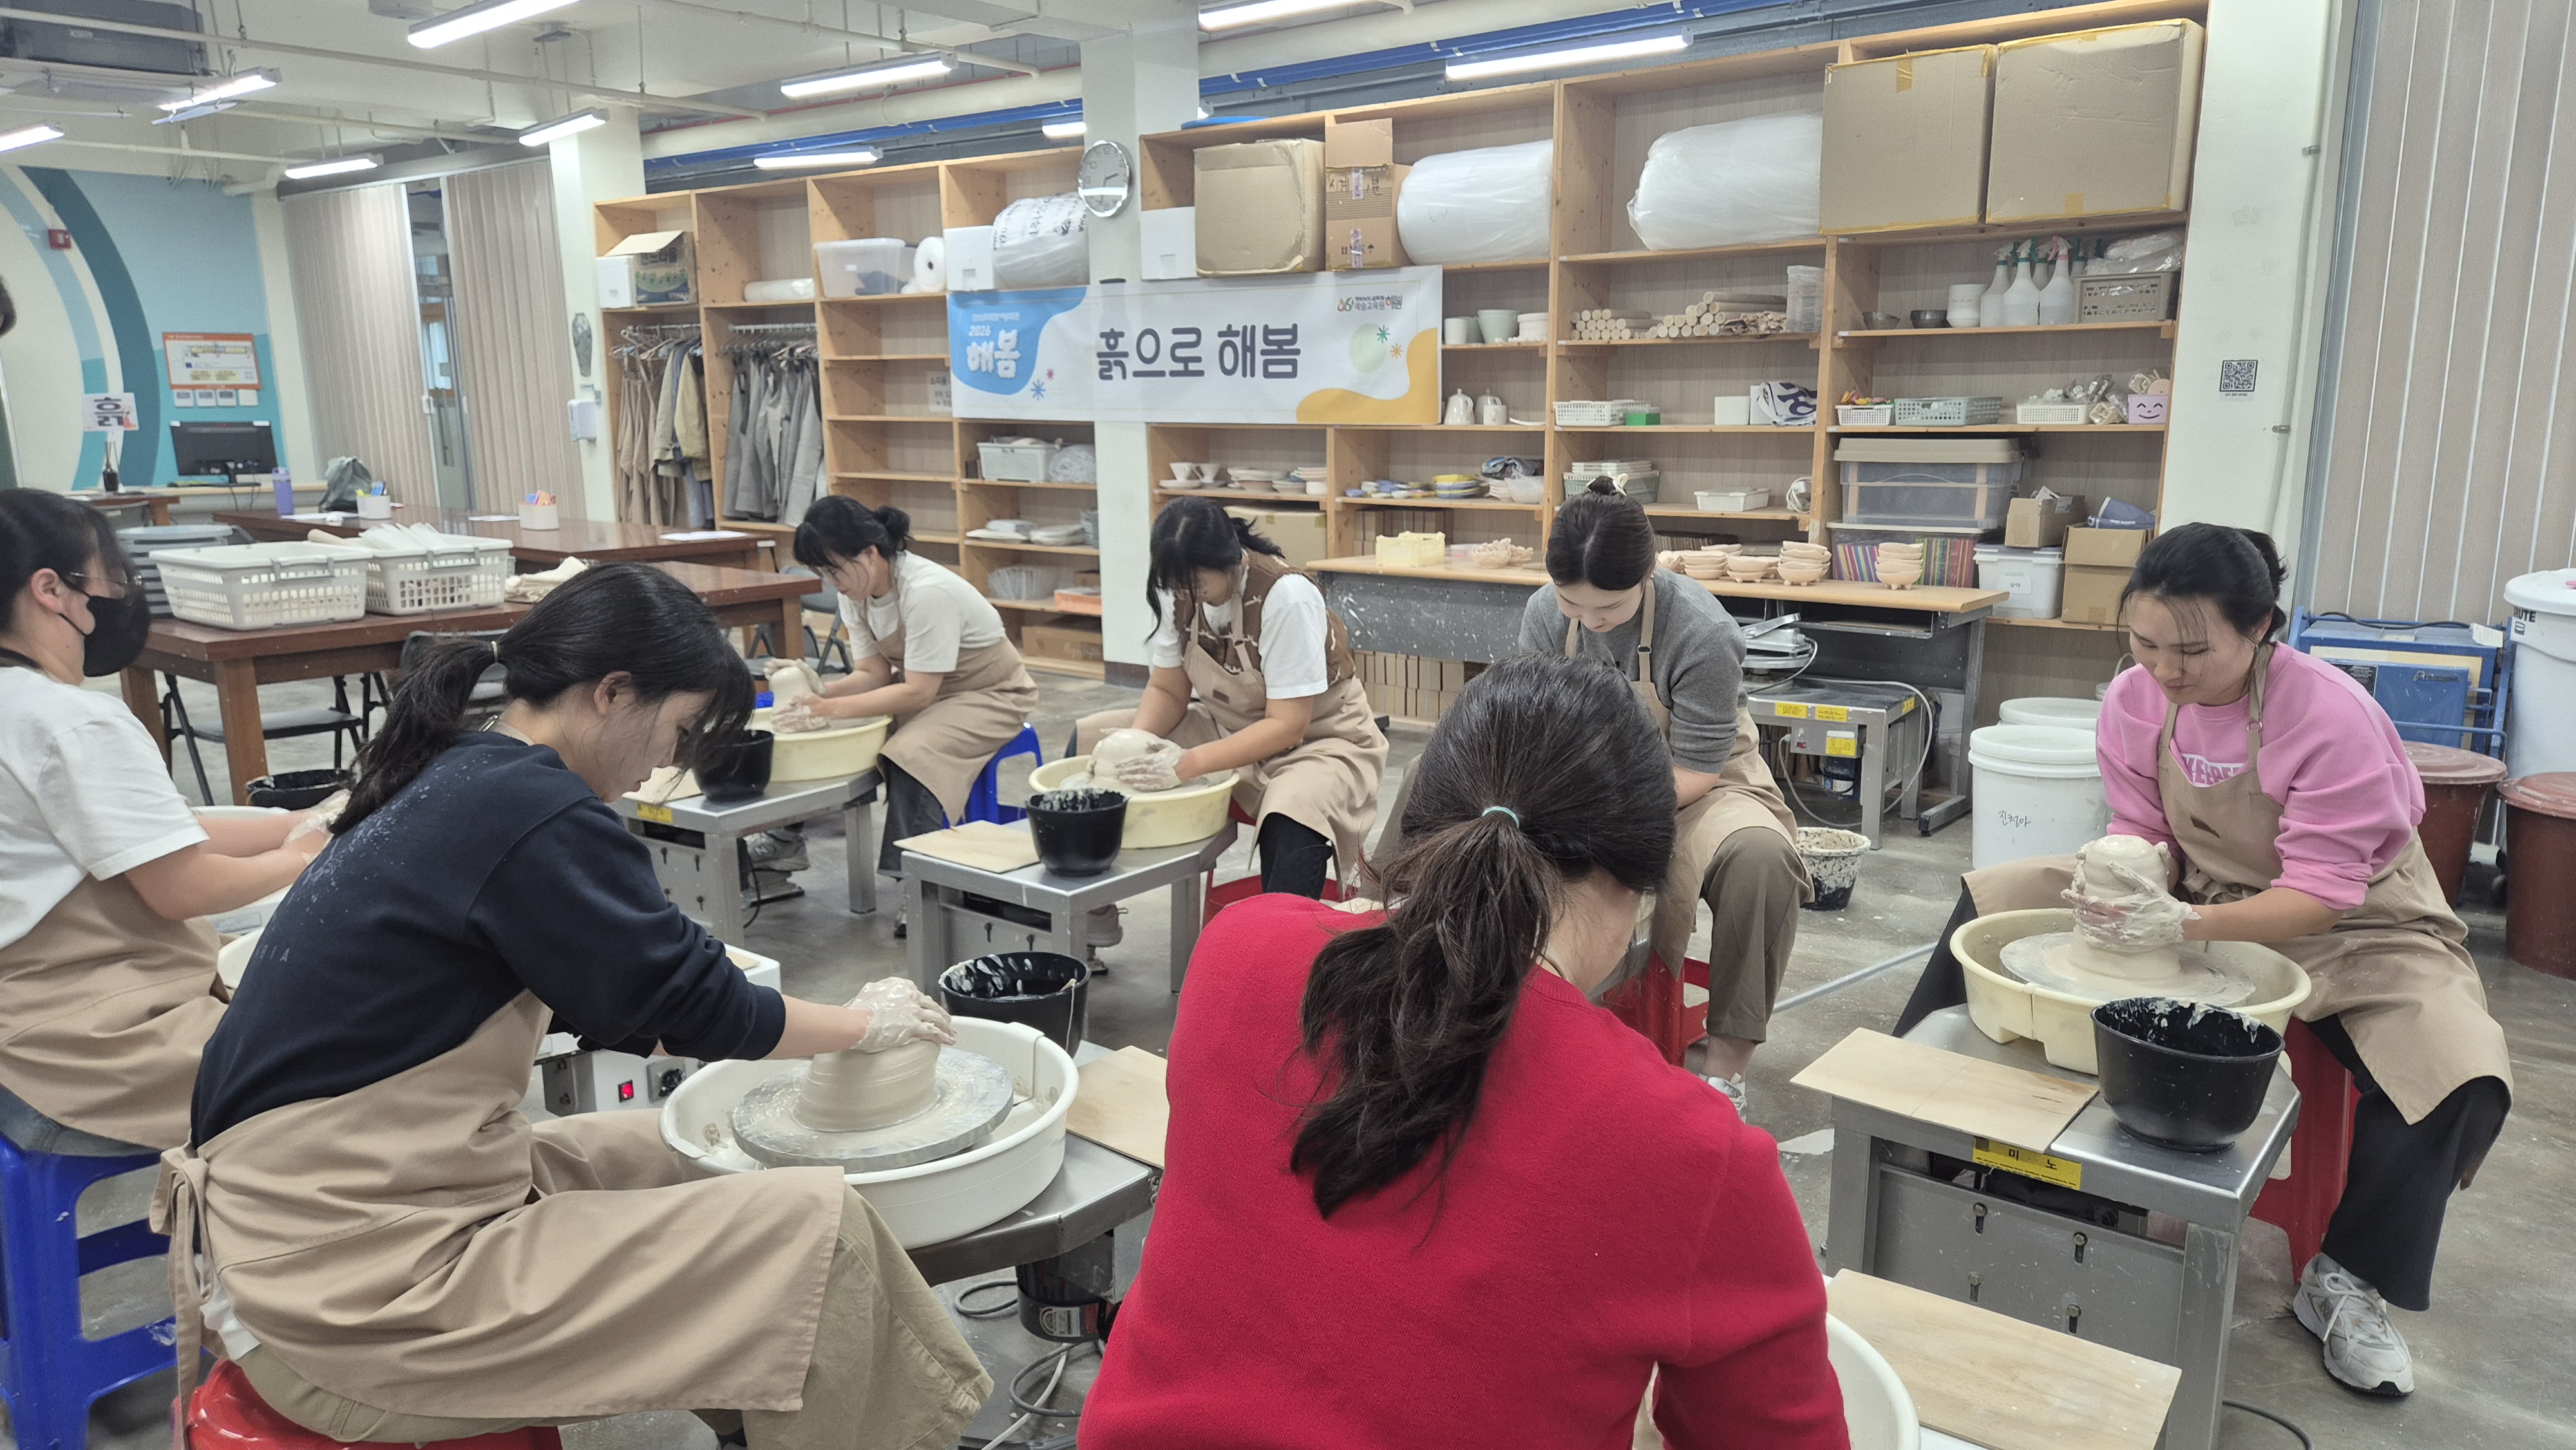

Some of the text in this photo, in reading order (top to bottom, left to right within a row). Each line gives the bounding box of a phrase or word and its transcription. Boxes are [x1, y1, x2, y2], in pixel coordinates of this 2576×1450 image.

[967, 329, 1021, 379] 해봄
[1096, 323, 1302, 381] 흙으로 해봄
